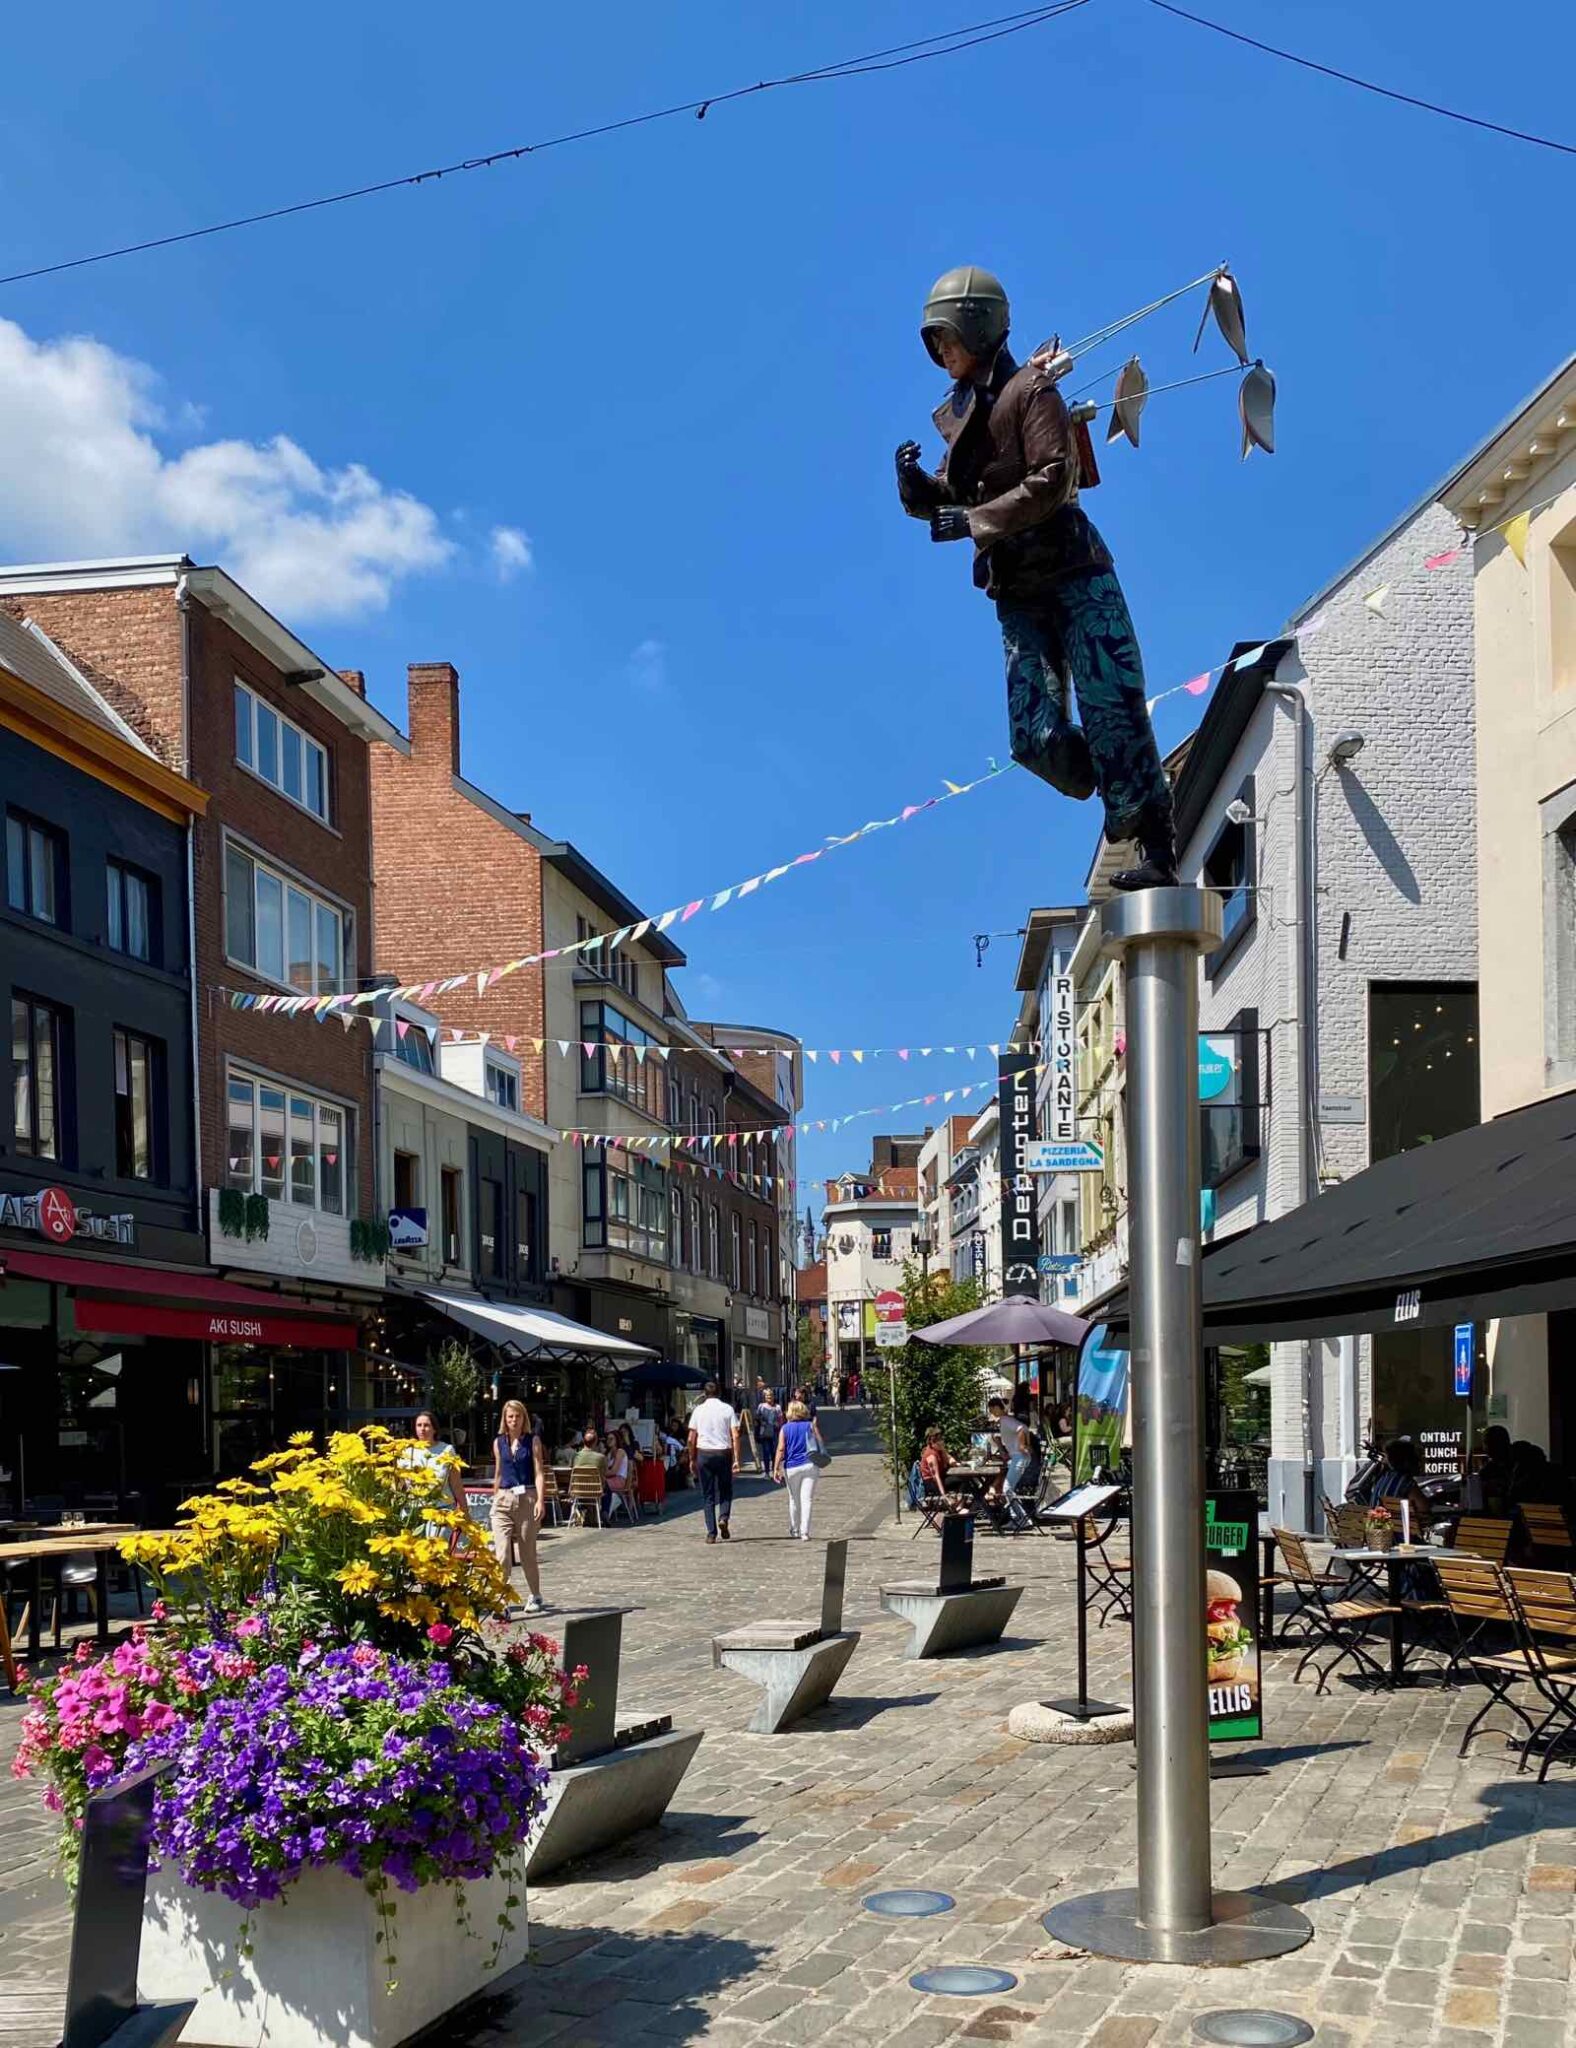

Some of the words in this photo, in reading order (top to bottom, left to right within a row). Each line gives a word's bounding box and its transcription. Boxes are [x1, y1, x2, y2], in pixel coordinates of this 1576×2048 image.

[1057, 979, 1071, 1137] RISTORANTE
[1041, 1146, 1087, 1155] PIZZERIA
[1030, 1158, 1042, 1167] LA
[1046, 1157, 1100, 1167] SARDEGNA
[74, 1207, 134, 1244] Sushi
[1394, 1289, 1421, 1322] ELLIS
[209, 1319, 227, 1334] AKI
[230, 1320, 262, 1336] SUSHI
[1420, 1431, 1462, 1443] ONTBIJT
[1424, 1447, 1458, 1458] LUNCH
[1424, 1462, 1459, 1474] KOFFIE
[1207, 1526, 1244, 1546] URGER
[1208, 1684, 1252, 1715] ELLIS
